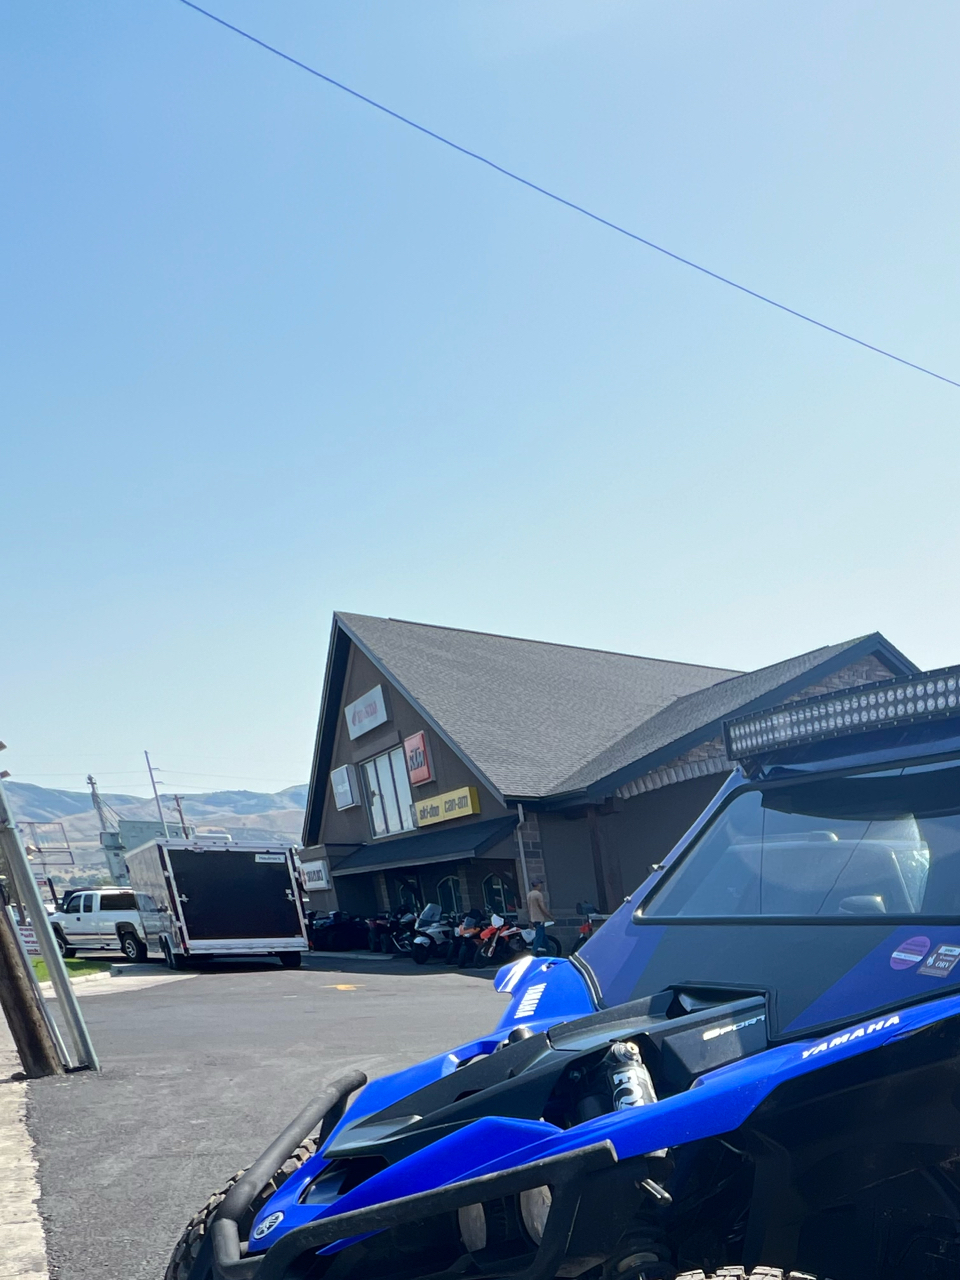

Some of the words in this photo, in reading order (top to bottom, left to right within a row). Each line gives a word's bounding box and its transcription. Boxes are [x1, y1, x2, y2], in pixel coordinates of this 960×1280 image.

[444, 794, 469, 813] can-am
[513, 982, 548, 1019] YAMAHA
[801, 1015, 900, 1060] YAMAHA
